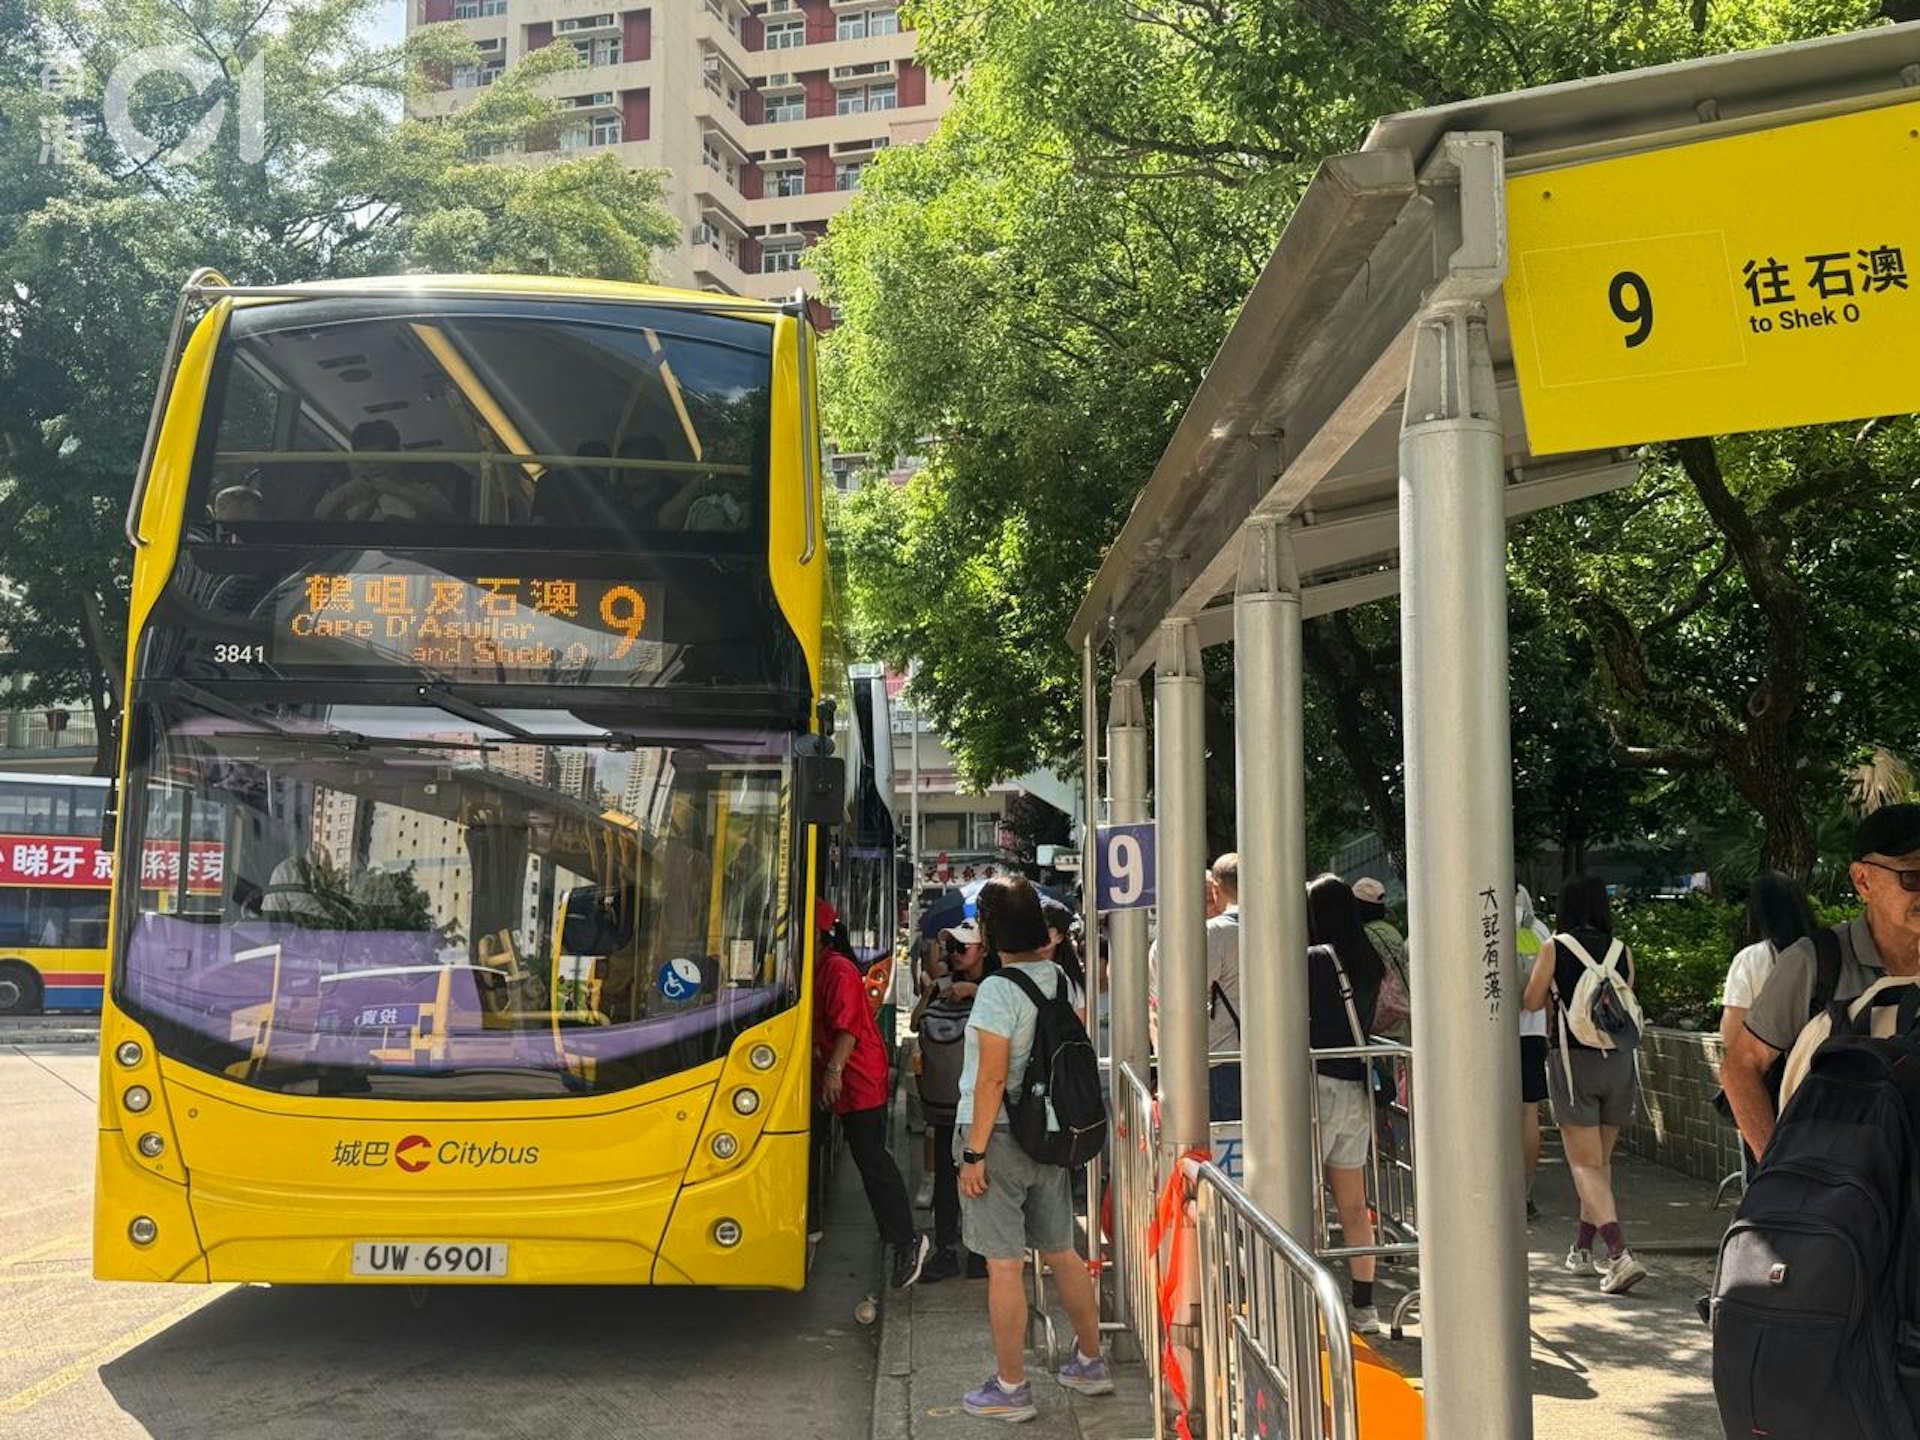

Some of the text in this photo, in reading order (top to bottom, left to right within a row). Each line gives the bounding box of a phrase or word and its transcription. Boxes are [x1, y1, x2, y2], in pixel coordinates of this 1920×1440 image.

[1608, 271, 1654, 348] 9
[1750, 304, 1860, 333] to Shek O
[305, 573, 578, 617] 鶴咀及石澳
[291, 614, 374, 638] Cape
[598, 584, 647, 660] 9
[214, 645, 265, 663] 3841
[412, 640, 461, 662] and
[475, 641, 552, 663] Shek
[1107, 834, 1144, 904] 9
[331, 1140, 389, 1167] 城巴
[437, 1141, 539, 1168] Citybus
[370, 1246, 492, 1271] UW 6901
